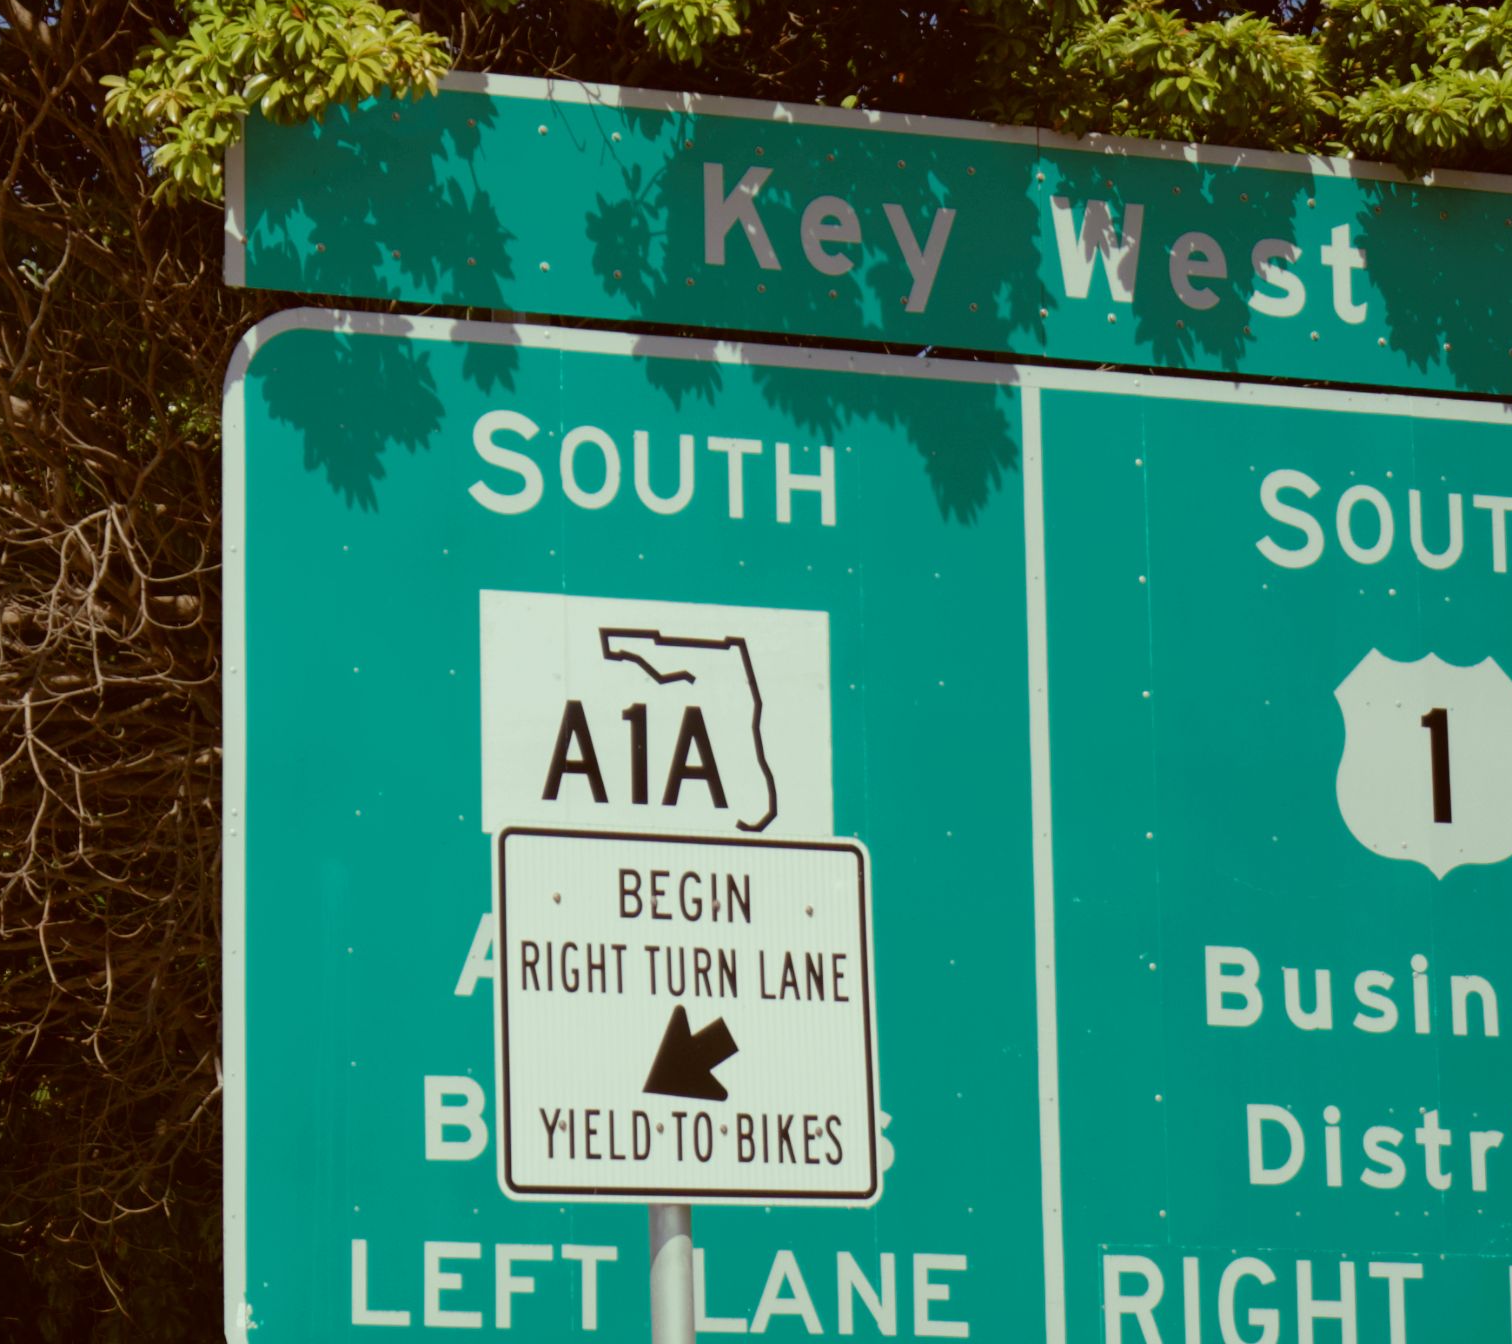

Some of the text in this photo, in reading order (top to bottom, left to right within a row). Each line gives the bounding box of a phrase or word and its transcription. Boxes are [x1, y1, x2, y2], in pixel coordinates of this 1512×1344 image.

[702, 162, 1369, 325] Key West
[467, 409, 837, 527] SOUTH
[541, 699, 729, 809] A1A
[1420, 707, 1453, 824] 1
[617, 868, 752, 924] BEGIN
[519, 939, 628, 995] RIGHT
[644, 945, 739, 998] TURN
[758, 949, 851, 1003] LANE
[539, 1107, 652, 1162] YIELD
[671, 1110, 714, 1163] TO
[735, 1113, 845, 1166] BIKES
[351, 1238, 970, 1338] LEFT LANE
